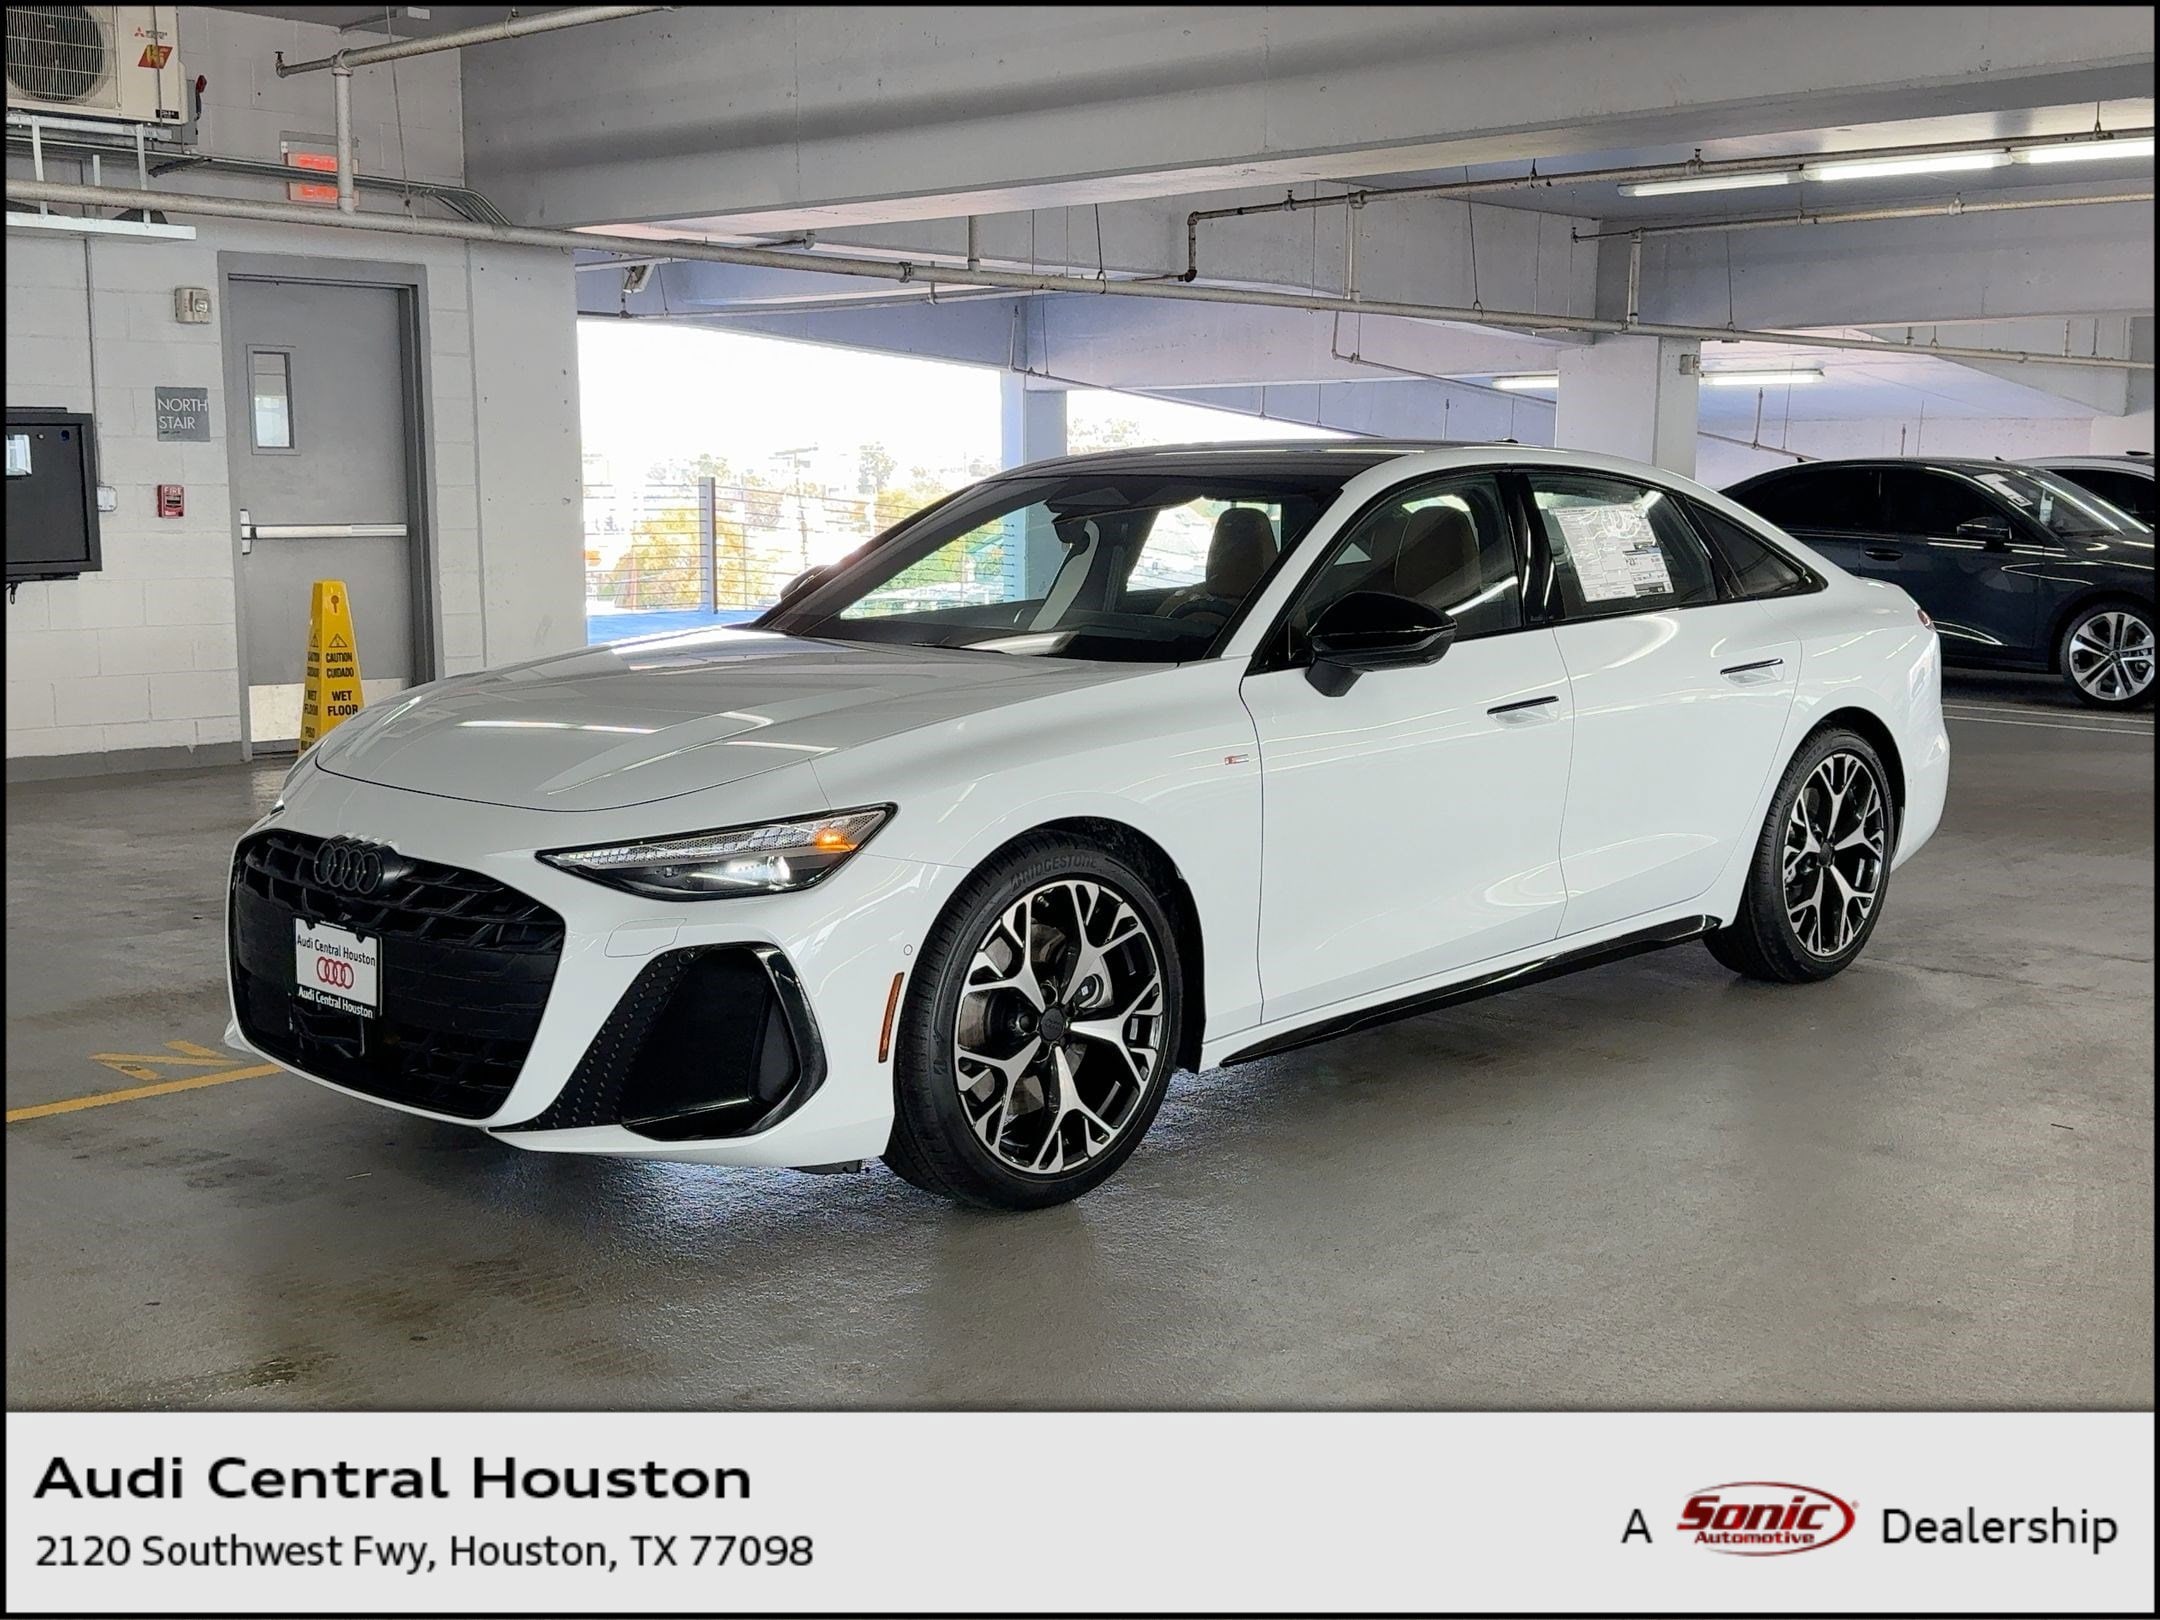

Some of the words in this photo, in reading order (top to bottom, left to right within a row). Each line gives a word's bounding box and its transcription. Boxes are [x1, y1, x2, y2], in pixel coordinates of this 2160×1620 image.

[157, 398, 208, 412] NORTH
[159, 416, 196, 429] STAIR
[164, 486, 183, 496] FIRE
[326, 652, 353, 663] CAUTION
[326, 667, 354, 678] CUIDADO
[331, 690, 353, 701] WET
[327, 704, 359, 717] FLOOR
[1011, 855, 1097, 892] BRIDGESTONE
[298, 934, 313, 949] Audi
[315, 939, 341, 957] Central
[344, 947, 376, 966] Houston
[298, 986, 314, 1001] Audi
[315, 992, 341, 1008] Central
[342, 999, 373, 1019] Houston
